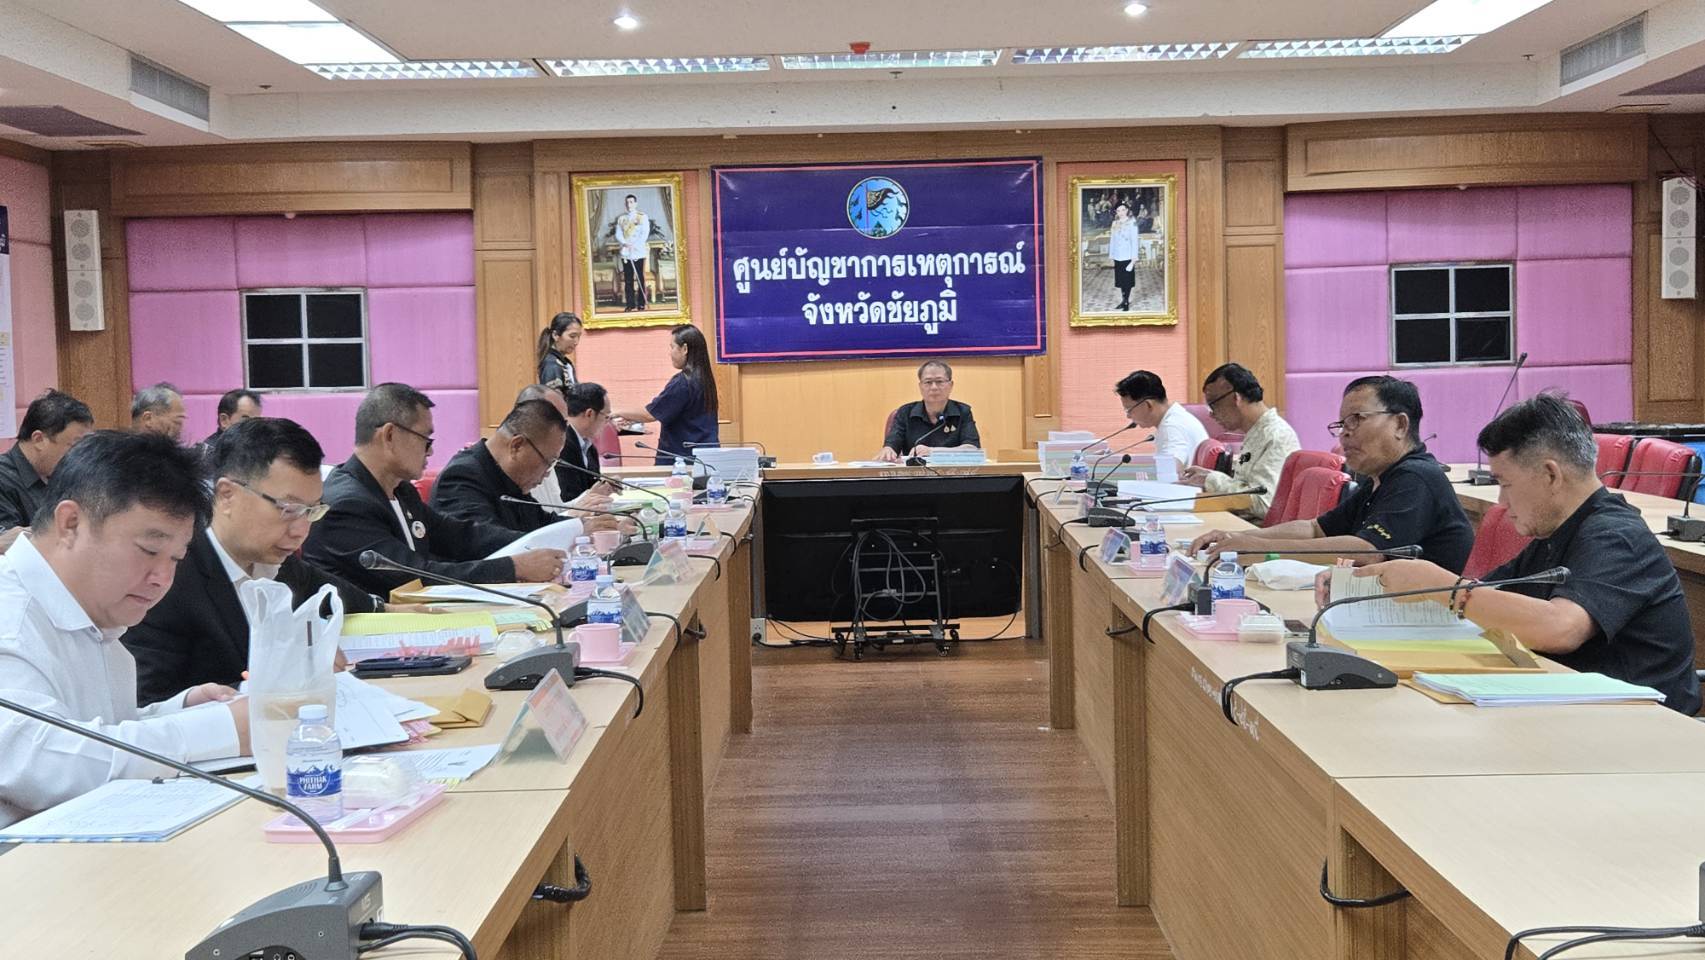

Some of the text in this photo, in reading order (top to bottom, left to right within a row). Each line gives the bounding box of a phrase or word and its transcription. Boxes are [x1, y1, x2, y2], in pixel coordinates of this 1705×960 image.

[733, 241, 1026, 293] ศูนย์บัญชาการเหตุการณ์
[802, 289, 957, 334] จังหวัดชัยภูมิ
